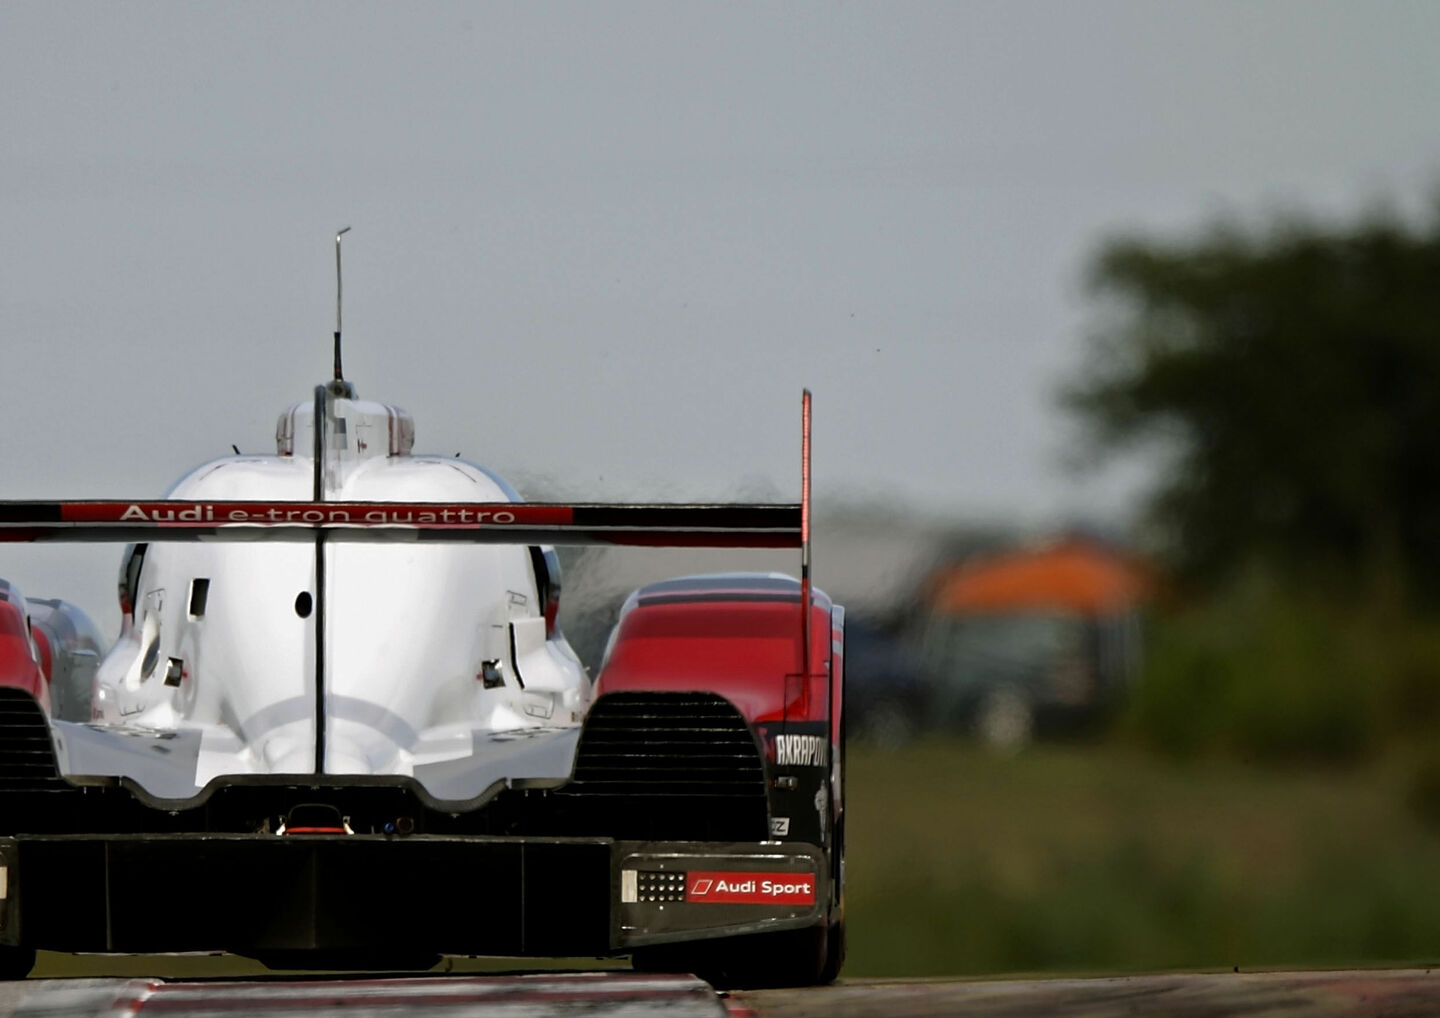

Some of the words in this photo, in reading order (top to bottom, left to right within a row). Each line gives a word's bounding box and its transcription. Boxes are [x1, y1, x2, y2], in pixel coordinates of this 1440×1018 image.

[120, 505, 214, 521] Audi
[227, 507, 350, 522] e-tron
[364, 508, 516, 524] quattro
[715, 880, 756, 893] Audi
[761, 880, 811, 896] Sport
